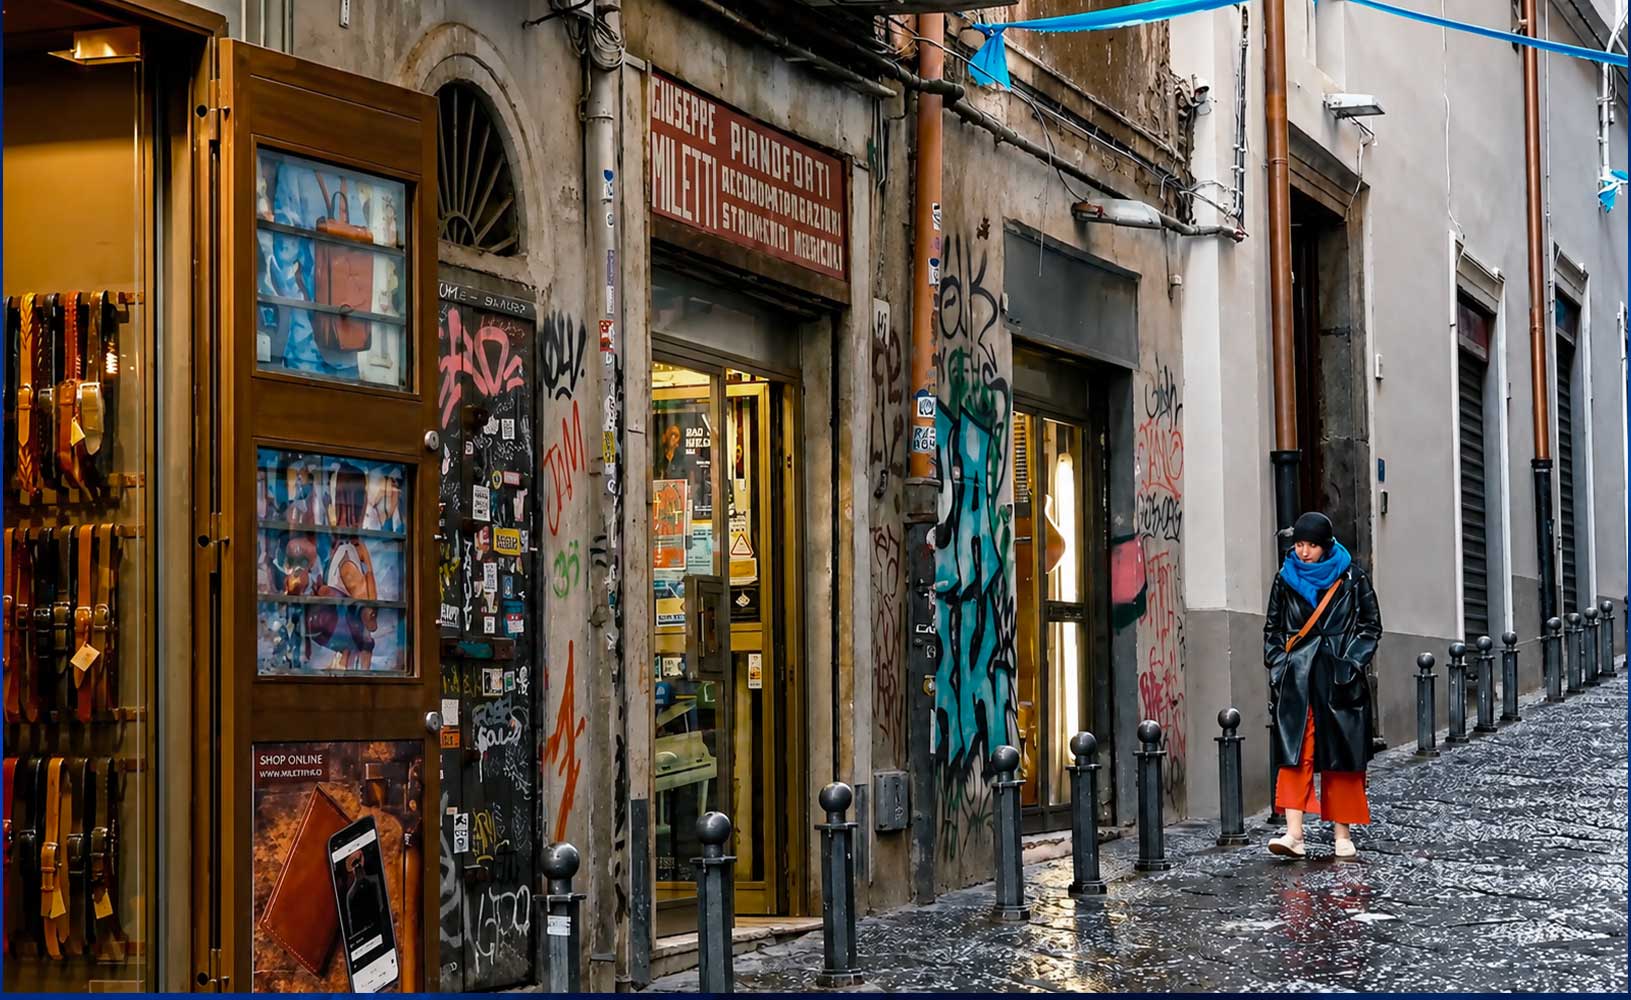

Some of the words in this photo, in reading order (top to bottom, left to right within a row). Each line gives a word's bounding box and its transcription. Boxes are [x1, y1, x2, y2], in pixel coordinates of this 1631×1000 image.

[651, 76, 717, 145] GIUSEPPE
[651, 131, 718, 230] MILETTI
[260, 755, 286, 765] SHOP
[288, 754, 322, 764] ONLINE
